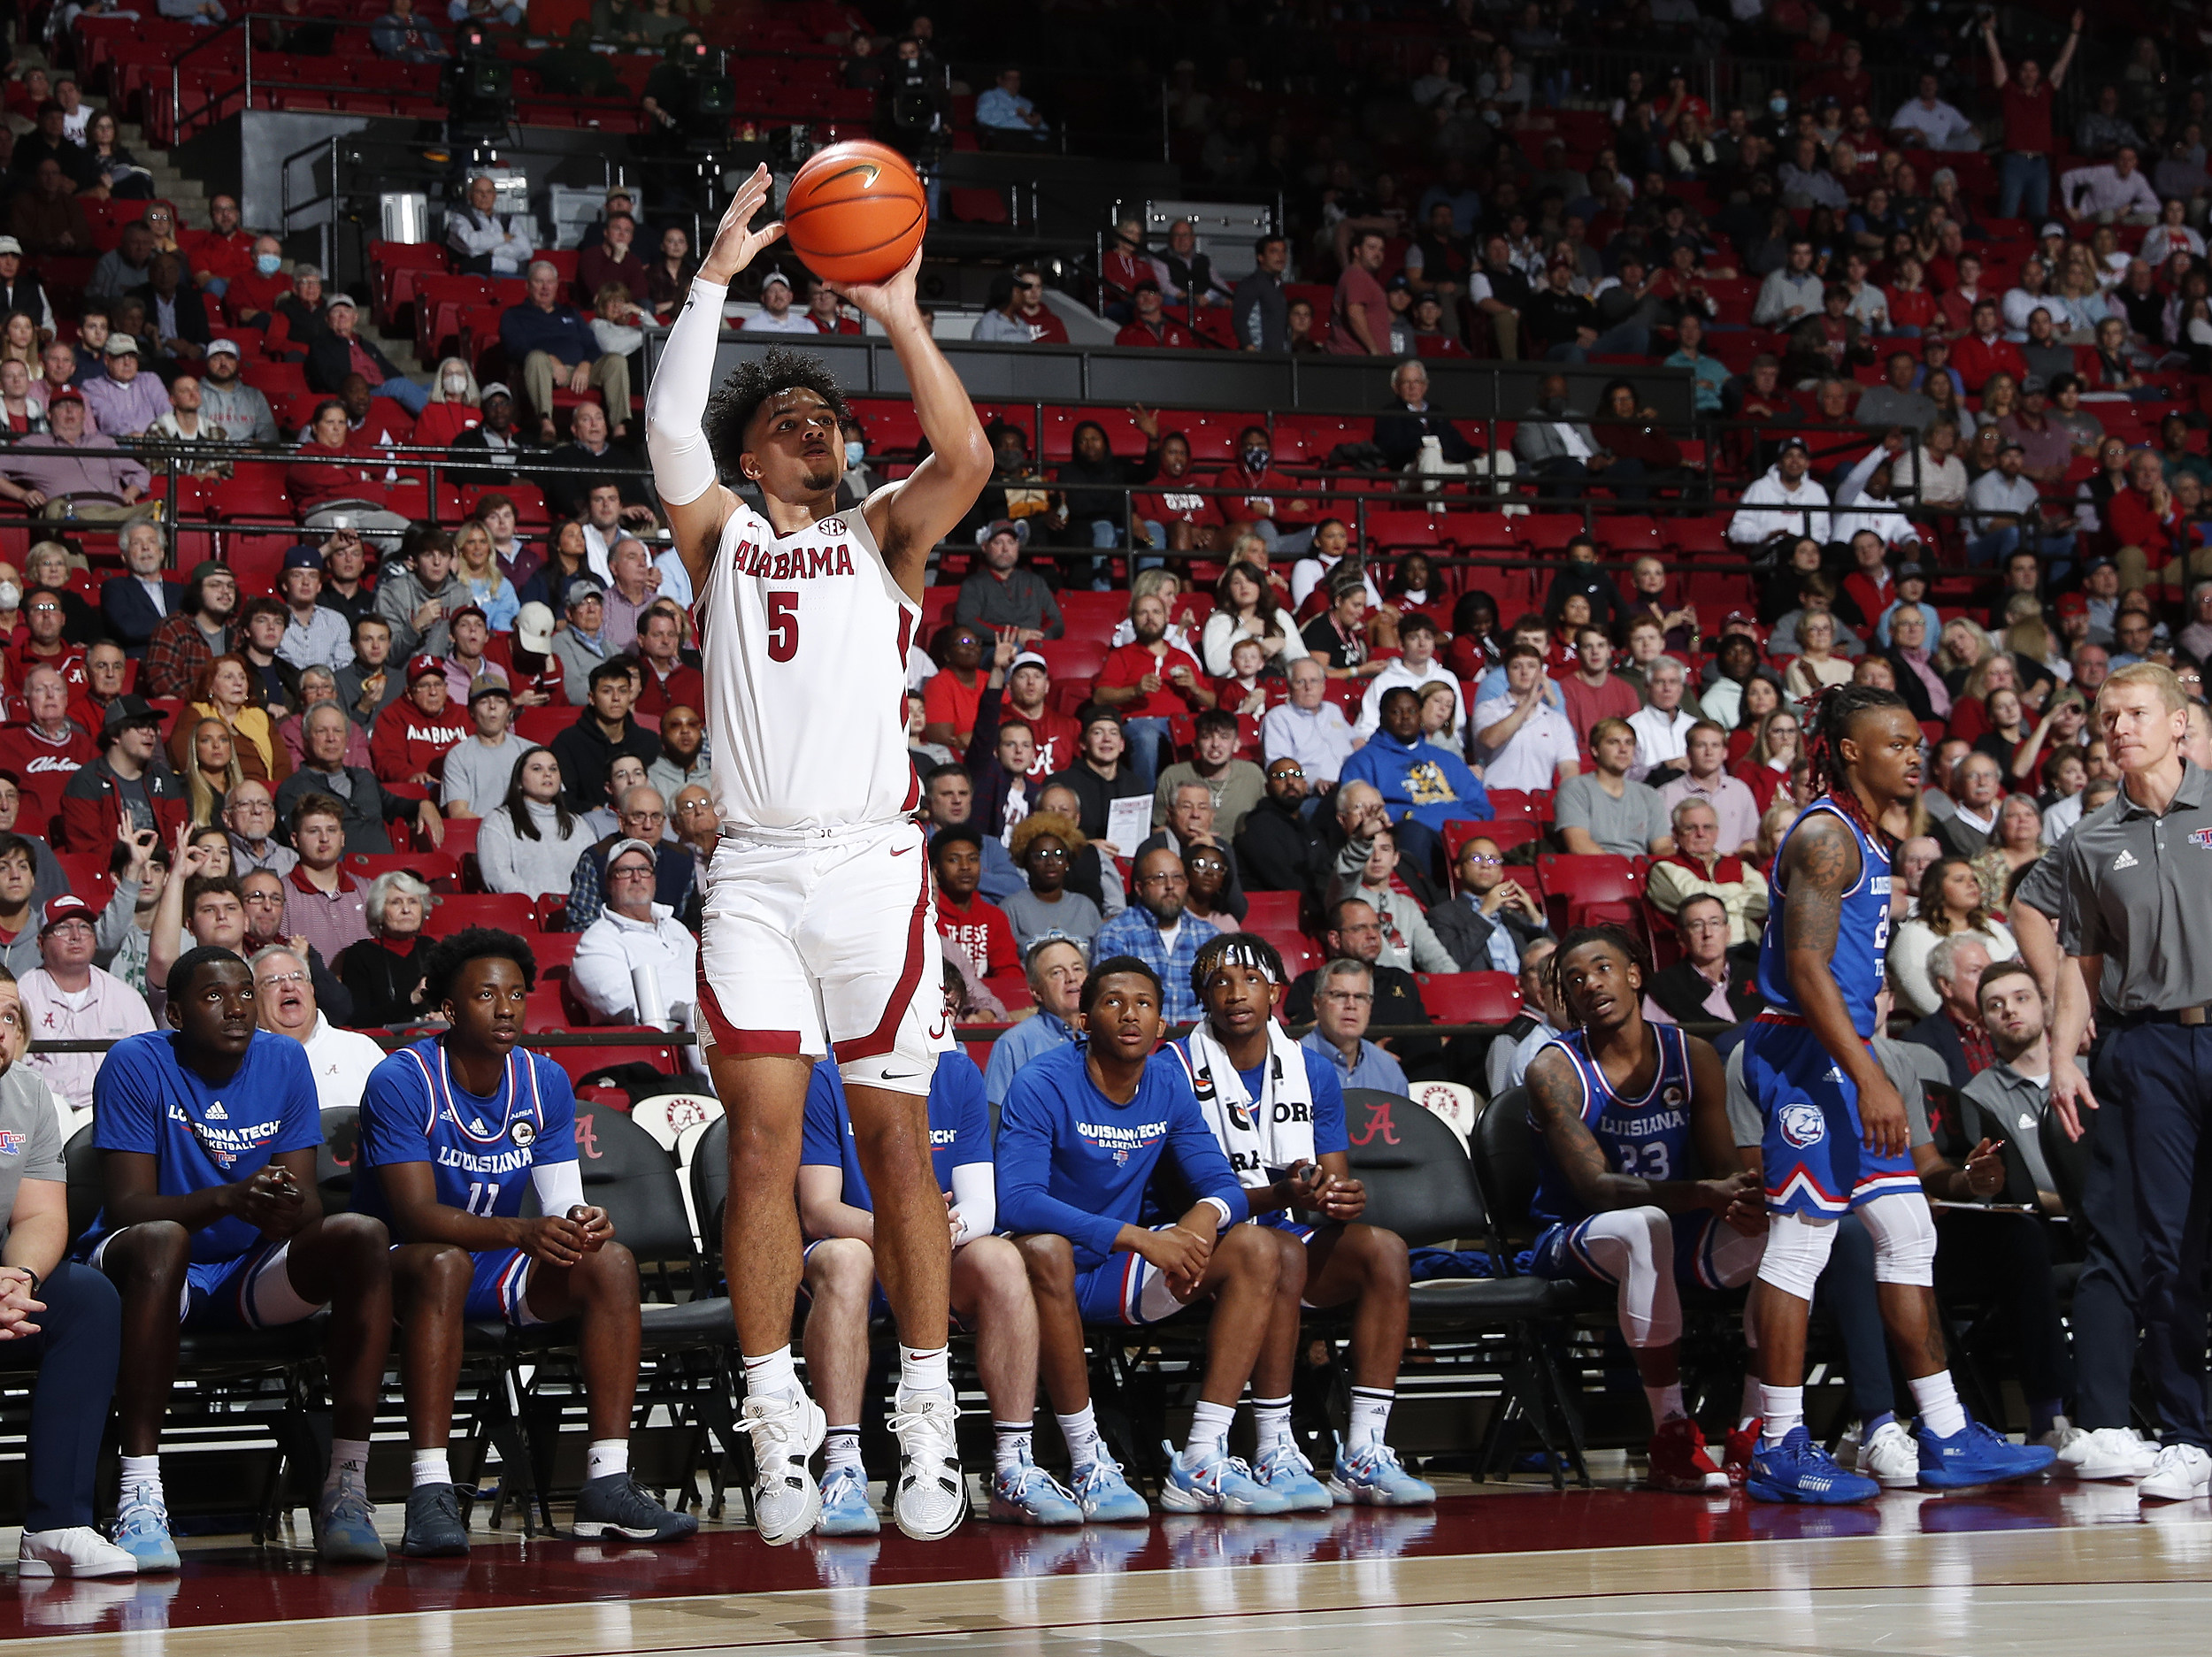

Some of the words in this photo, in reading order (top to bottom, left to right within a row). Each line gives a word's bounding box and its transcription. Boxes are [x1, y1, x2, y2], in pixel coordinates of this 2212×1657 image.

[819, 518, 846, 535] SEC
[733, 540, 855, 580] ALABAMA
[767, 591, 800, 664] 5
[419, 655, 434, 668] A
[69, 669, 84, 684] A
[407, 724, 468, 744] ALABAMA
[1025, 743, 1055, 776] A
[41, 1012, 57, 1029] A
[325, 1063, 339, 1076] A
[238, 1120, 280, 1142] TECH
[1348, 1101, 1402, 1146] A
[437, 1146, 533, 1175] LOUISIANA
[1618, 1140, 1671, 1181] 23
[465, 1182, 500, 1218] 11
